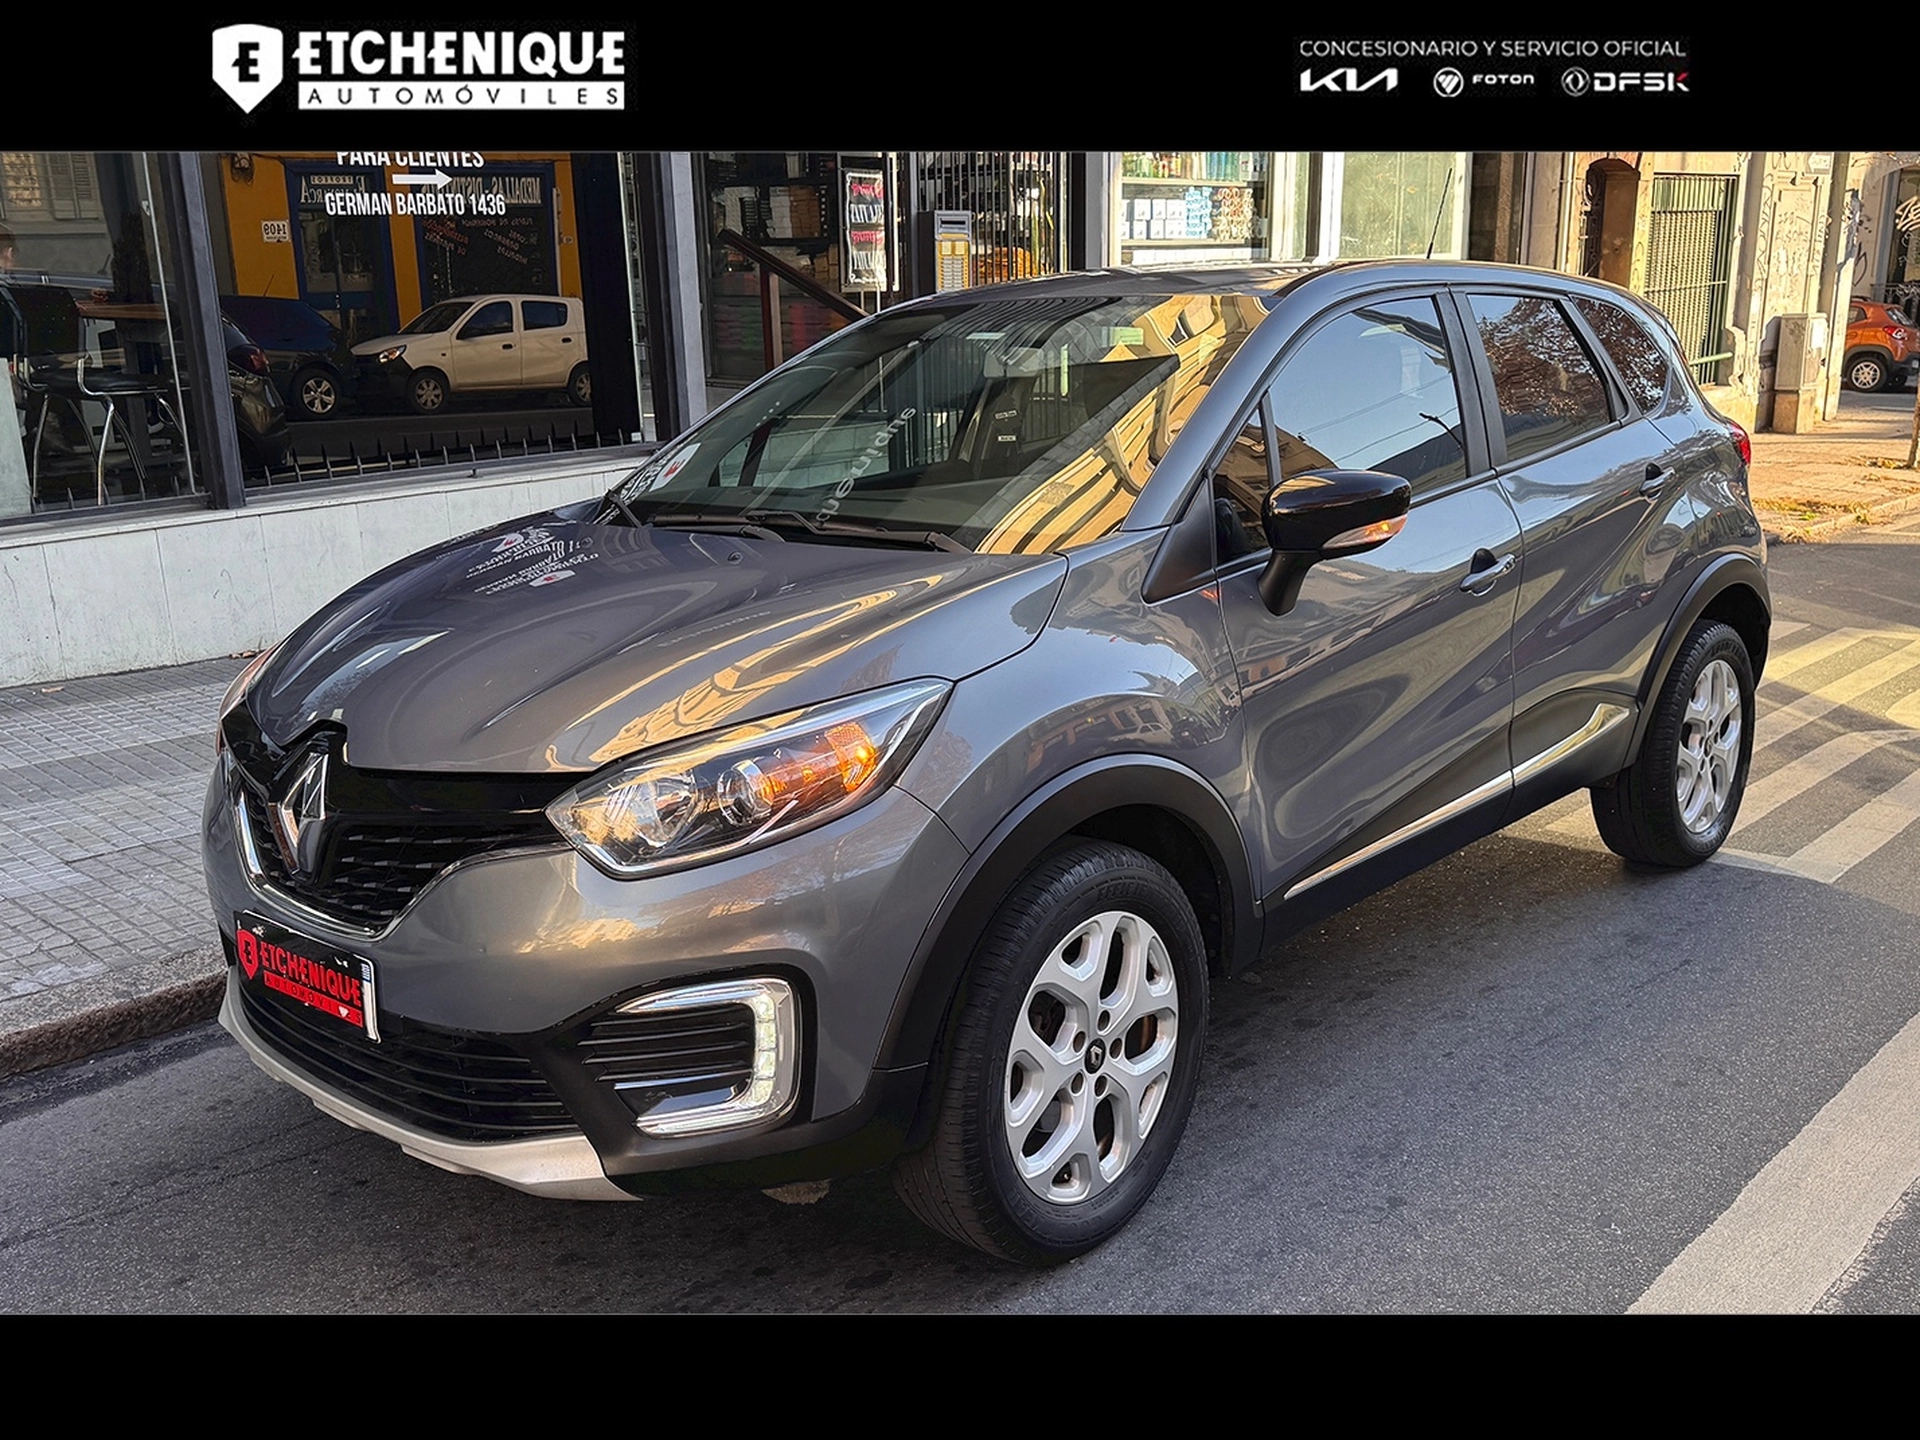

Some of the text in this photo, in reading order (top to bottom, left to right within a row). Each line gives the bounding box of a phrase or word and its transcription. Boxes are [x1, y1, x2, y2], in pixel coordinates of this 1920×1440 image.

[337, 151, 485, 168] PARA CLIENTES
[324, 192, 507, 216] GERMAN BARBATO 1436
